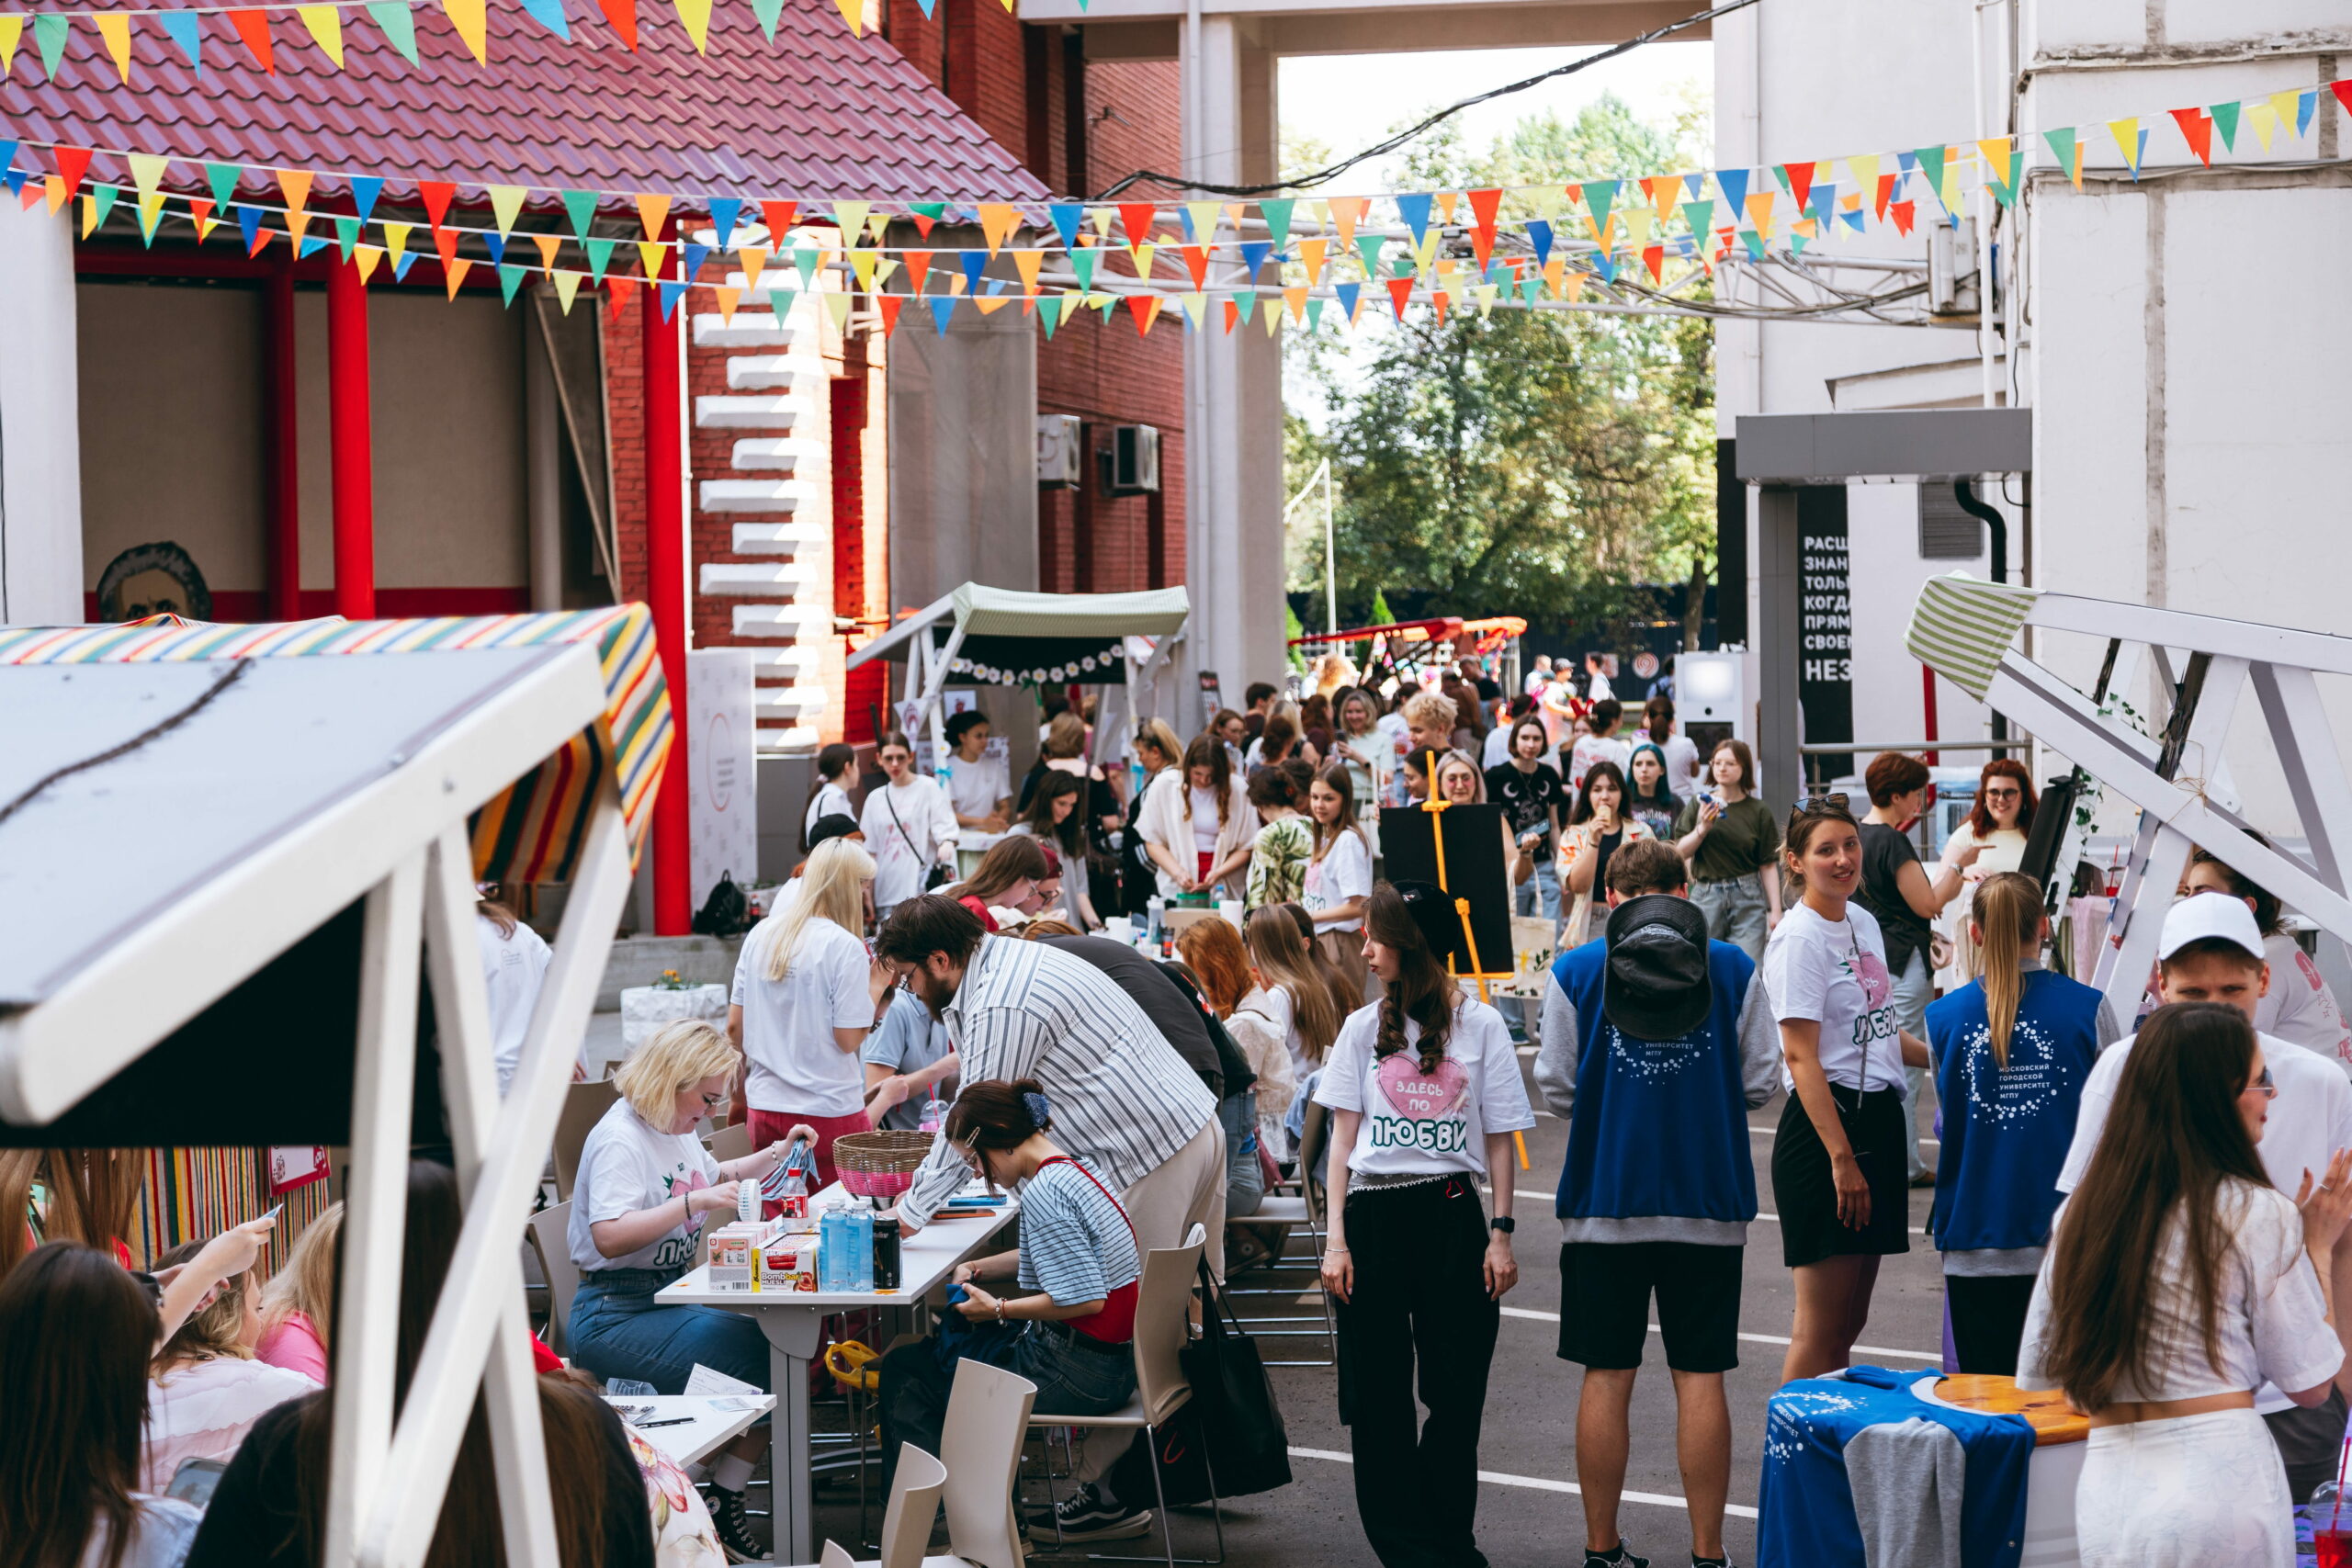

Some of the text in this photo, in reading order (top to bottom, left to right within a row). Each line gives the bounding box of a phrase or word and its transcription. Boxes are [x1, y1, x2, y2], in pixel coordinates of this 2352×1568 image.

[1804, 595, 1851, 614] КОГД
[1804, 615, 1850, 630] ПРЯМ
[1805, 658, 1852, 682] НЕЗ
[1998, 1063, 2050, 1073] МОСКОВСКИЙ
[1999, 1073, 2043, 1082] ГОРОДСКОЙ
[1396, 1080, 1444, 1097] ЗДЕСЬ
[1999, 1082, 2051, 1091] УНИВЕРСИТЕТ
[1408, 1098, 1430, 1112] ПО
[761, 1271, 799, 1281] Bombbar
